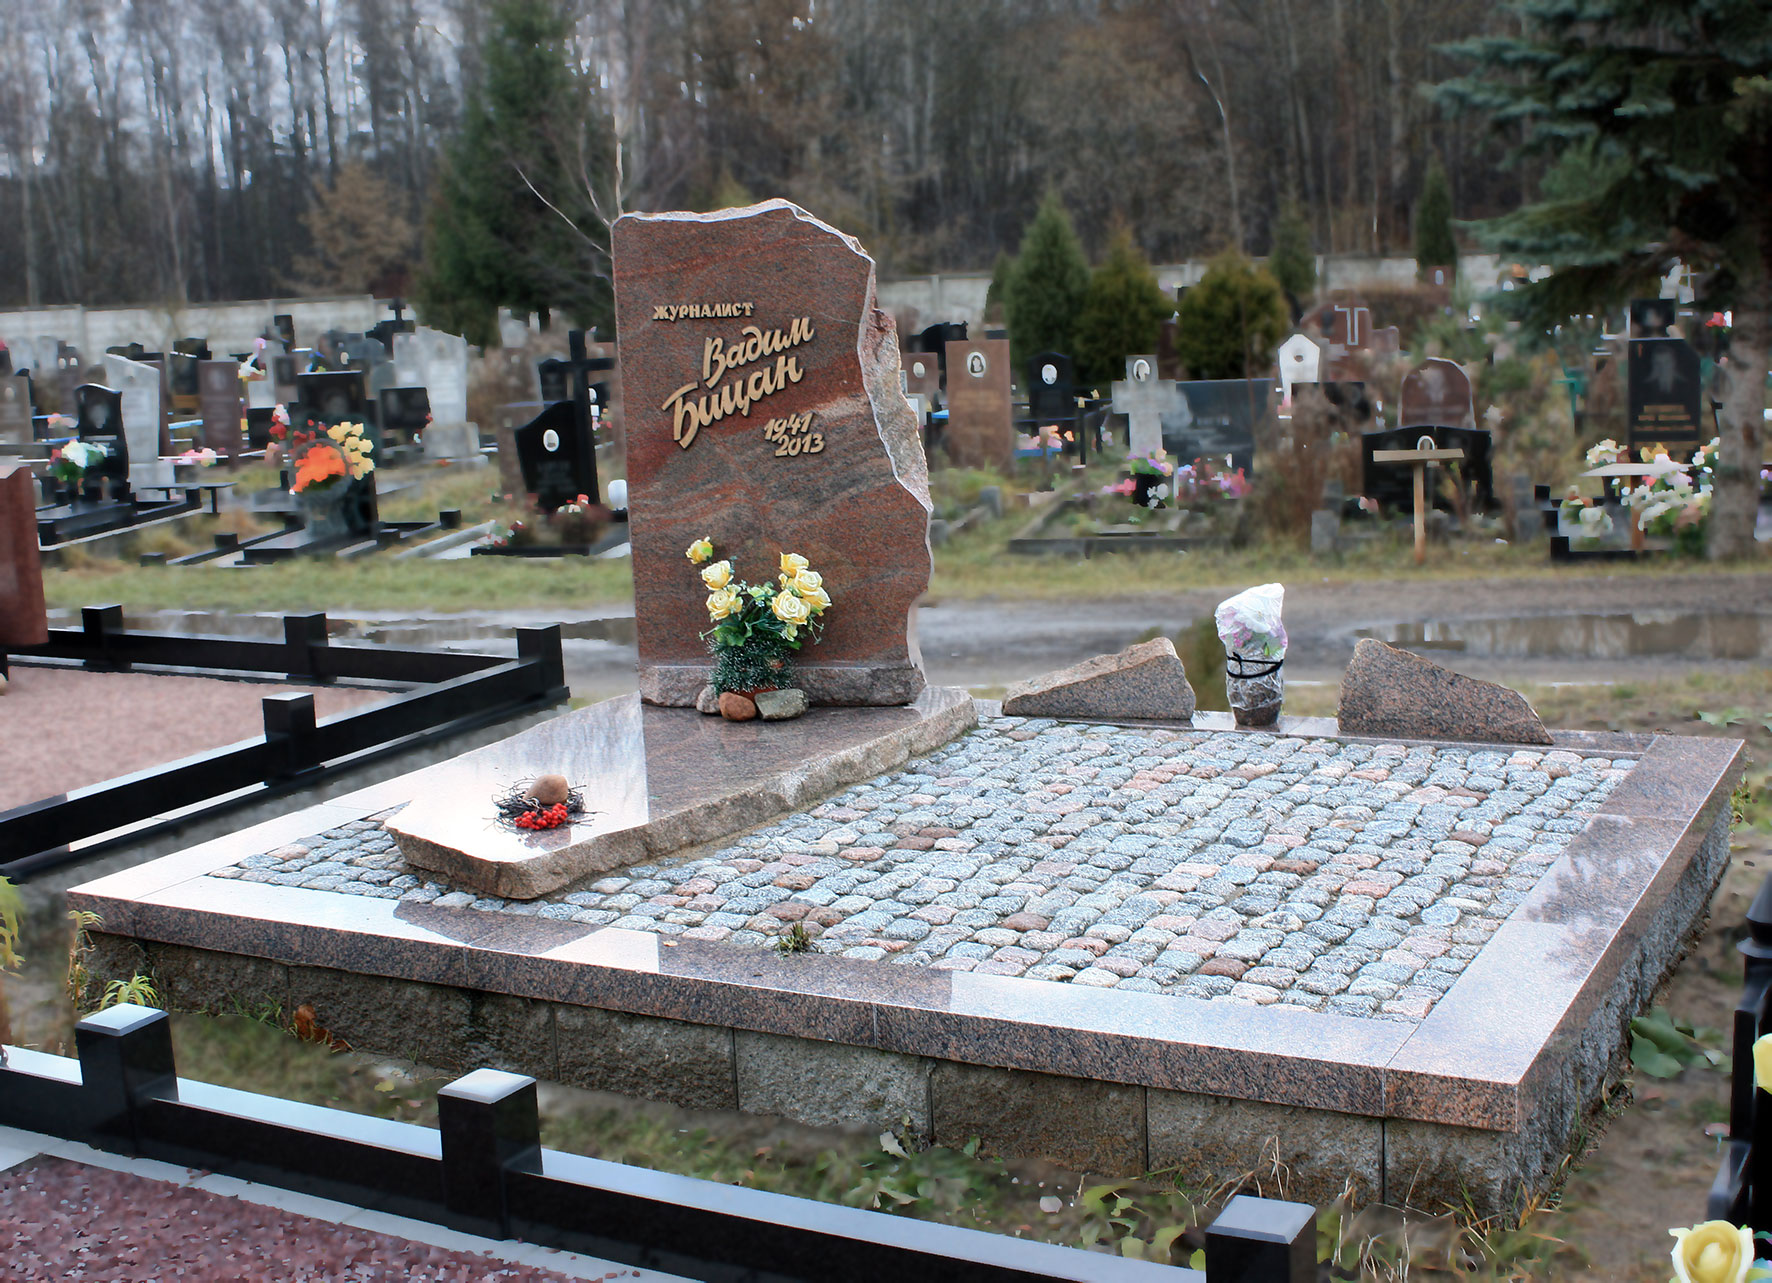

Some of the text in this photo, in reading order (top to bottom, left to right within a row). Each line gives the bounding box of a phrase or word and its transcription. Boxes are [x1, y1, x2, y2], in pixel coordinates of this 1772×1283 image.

[652, 302, 754, 321] ЖУРНАЛИСТ
[702, 317, 814, 388] Вадим
[764, 413, 814, 441] 1941
[774, 433, 825, 457] 2013
